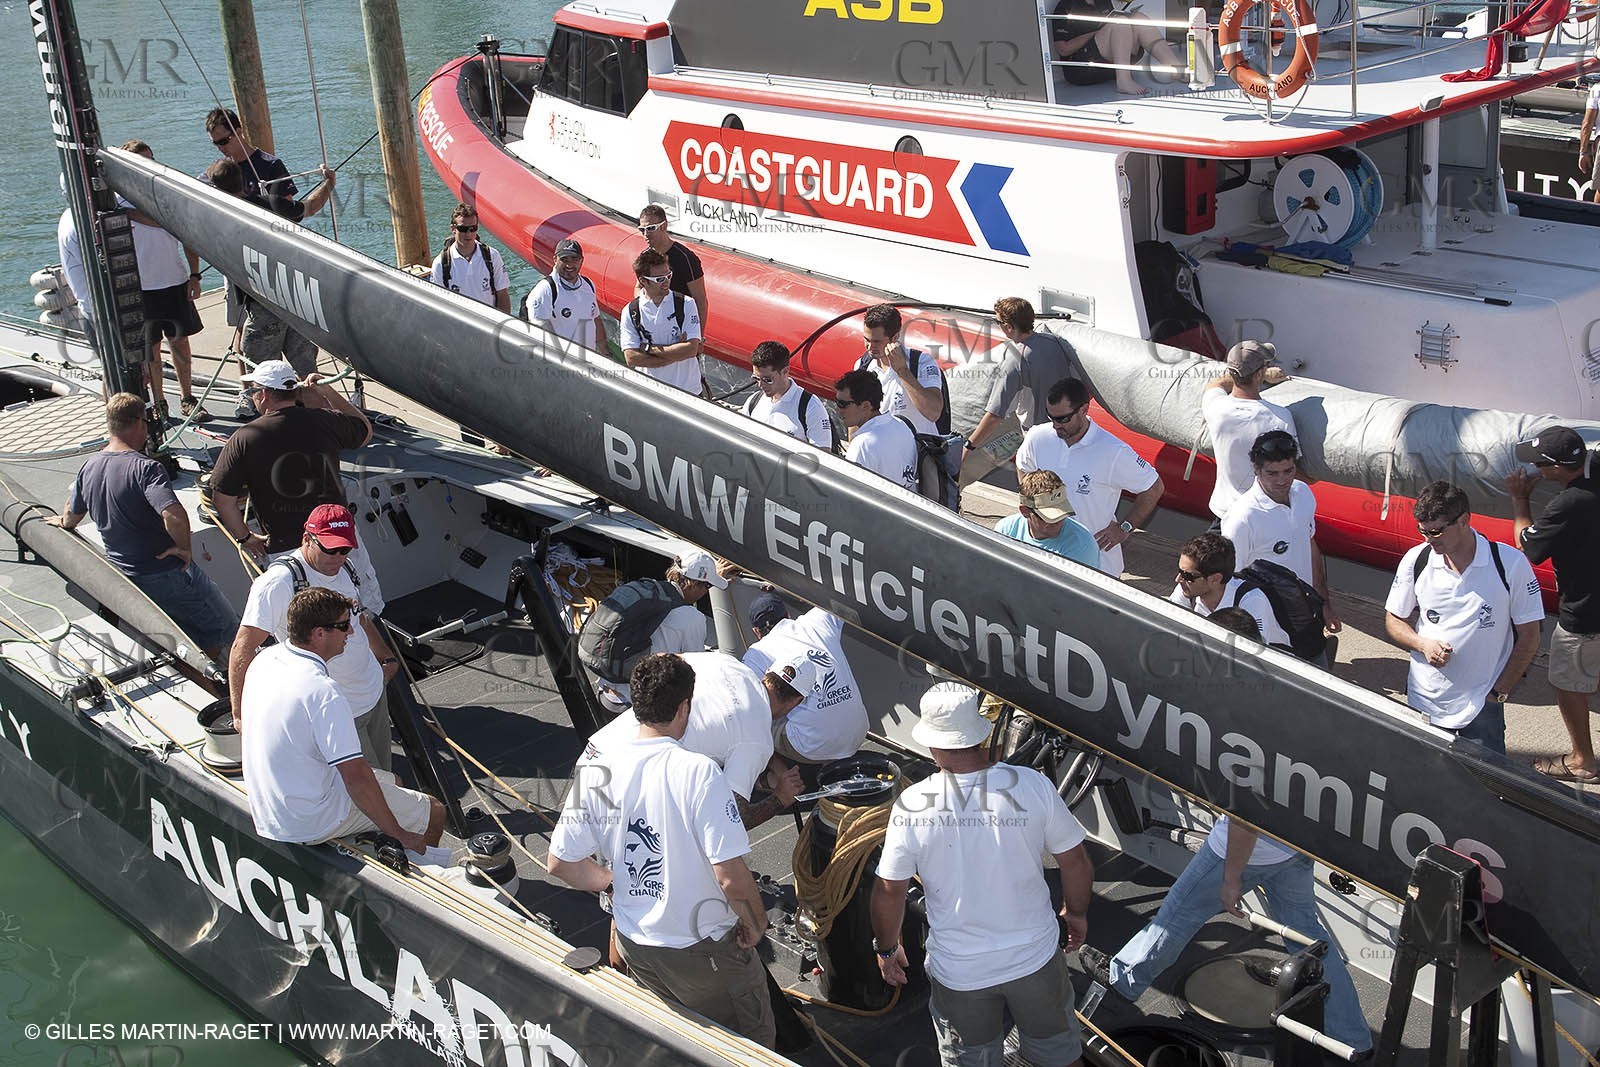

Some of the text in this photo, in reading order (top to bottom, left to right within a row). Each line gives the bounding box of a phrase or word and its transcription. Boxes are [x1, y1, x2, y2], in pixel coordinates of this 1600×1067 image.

[1222, 1, 1239, 27] ASB
[419, 100, 455, 158] RESCUE
[680, 138, 934, 219] COASTGUARD
[1500, 167, 1594, 202] ITY
[684, 200, 758, 228] AUCKLAND
[243, 245, 329, 333] SLAM
[603, 422, 749, 545] BMW
[827, 684, 853, 700] GREEK
